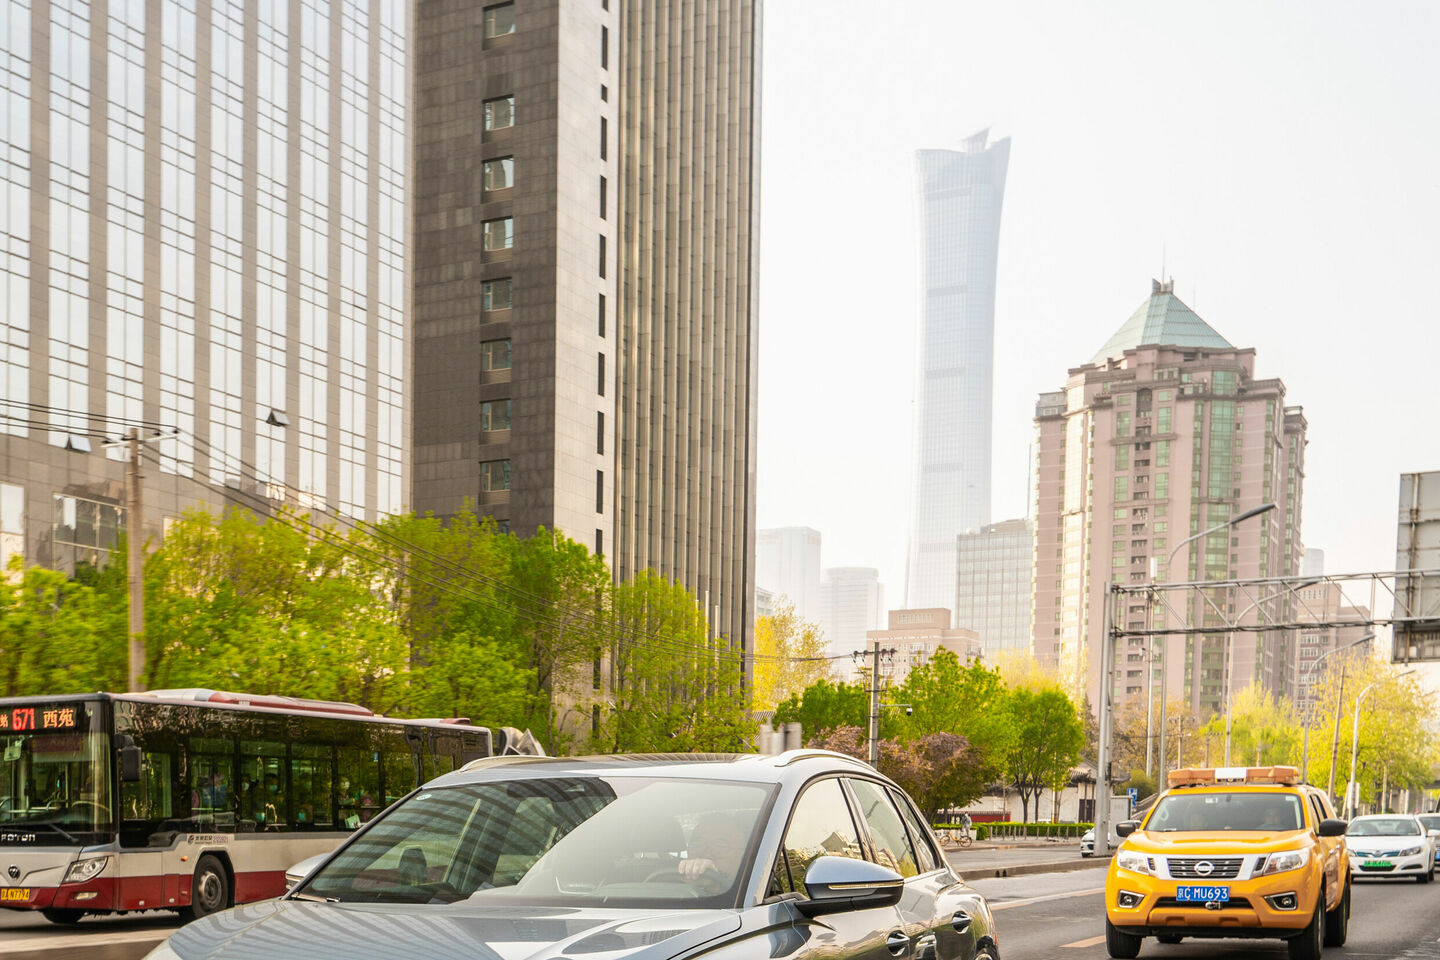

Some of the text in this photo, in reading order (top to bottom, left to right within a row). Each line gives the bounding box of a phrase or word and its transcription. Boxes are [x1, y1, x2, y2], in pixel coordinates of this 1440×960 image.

[12, 708, 35, 730] 671
[43, 708, 74, 728] 西苑
[1, 834, 36, 842] FOTON
